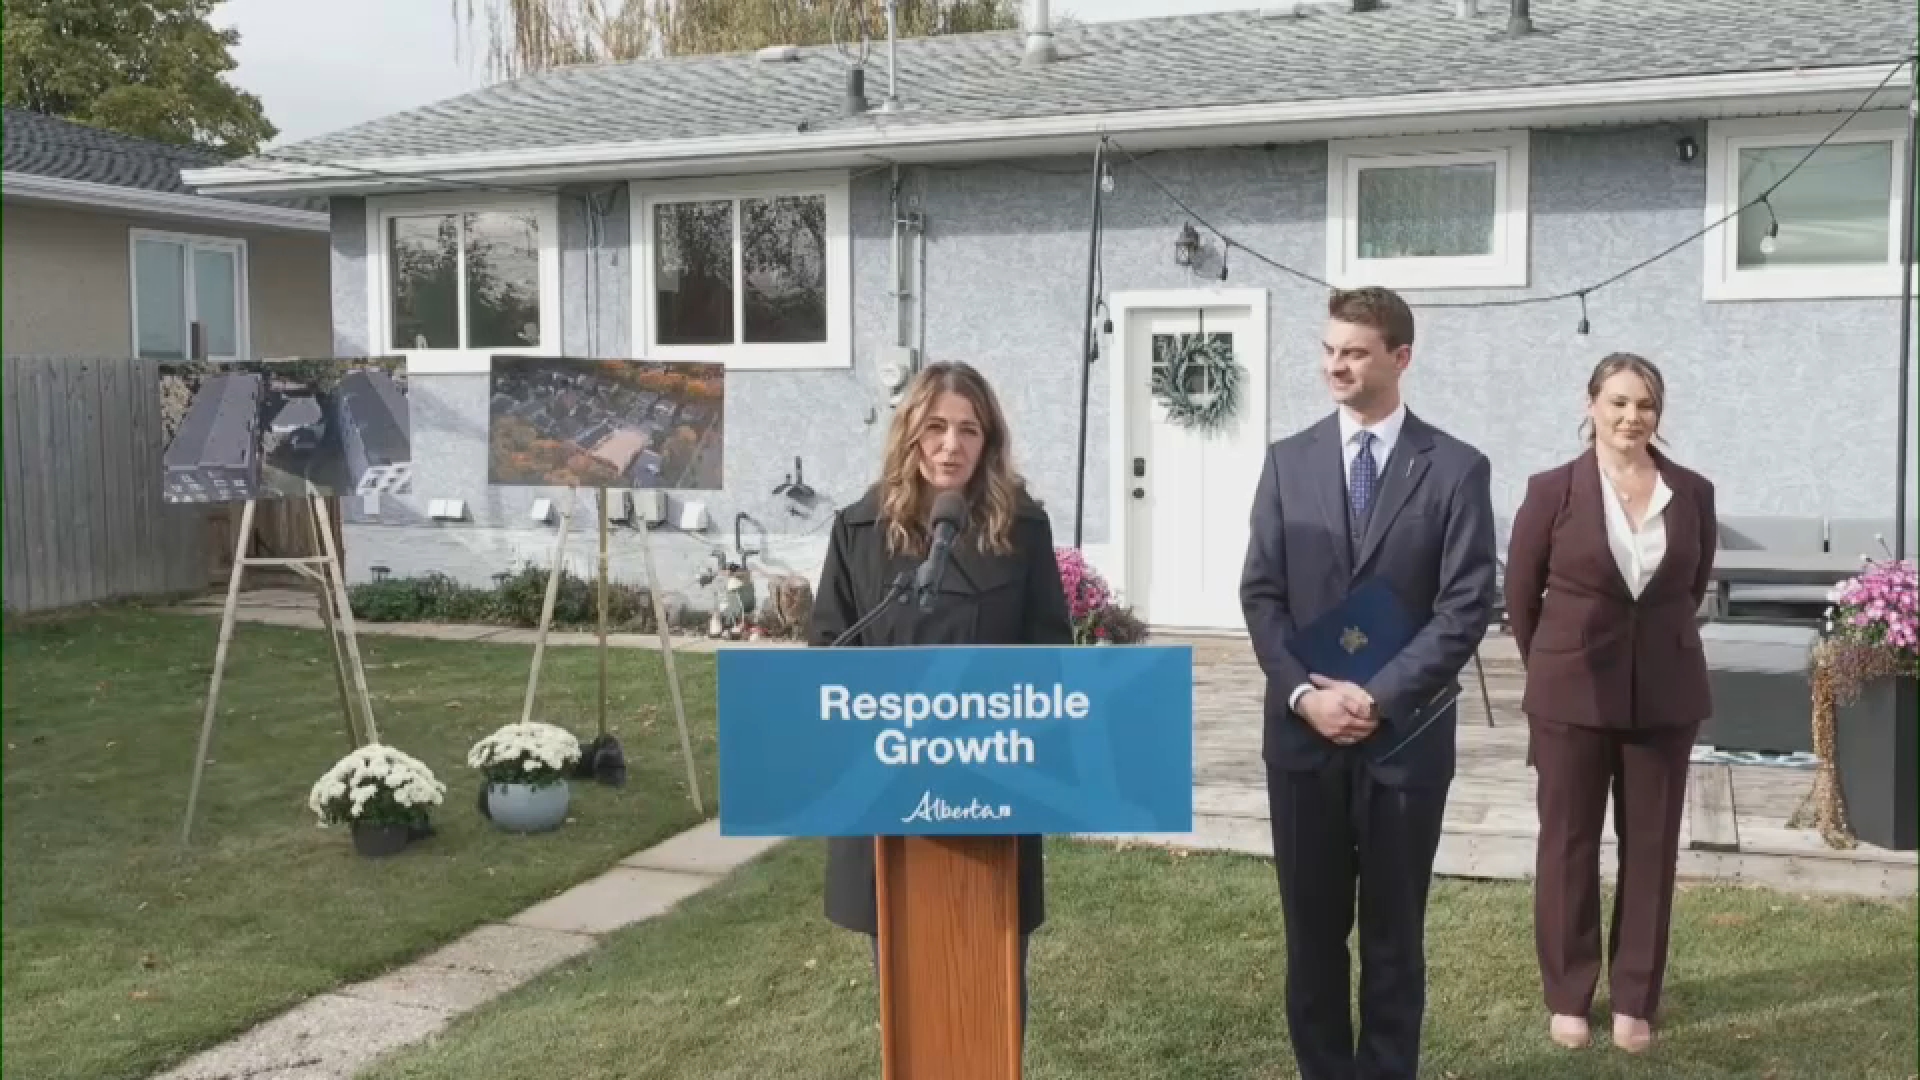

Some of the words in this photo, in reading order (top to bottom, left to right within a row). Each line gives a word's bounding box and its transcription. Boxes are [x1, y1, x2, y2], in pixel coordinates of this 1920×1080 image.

[820, 683, 1089, 727] Responsible
[875, 729, 1035, 764] Growth
[901, 789, 1002, 822] Alberta
